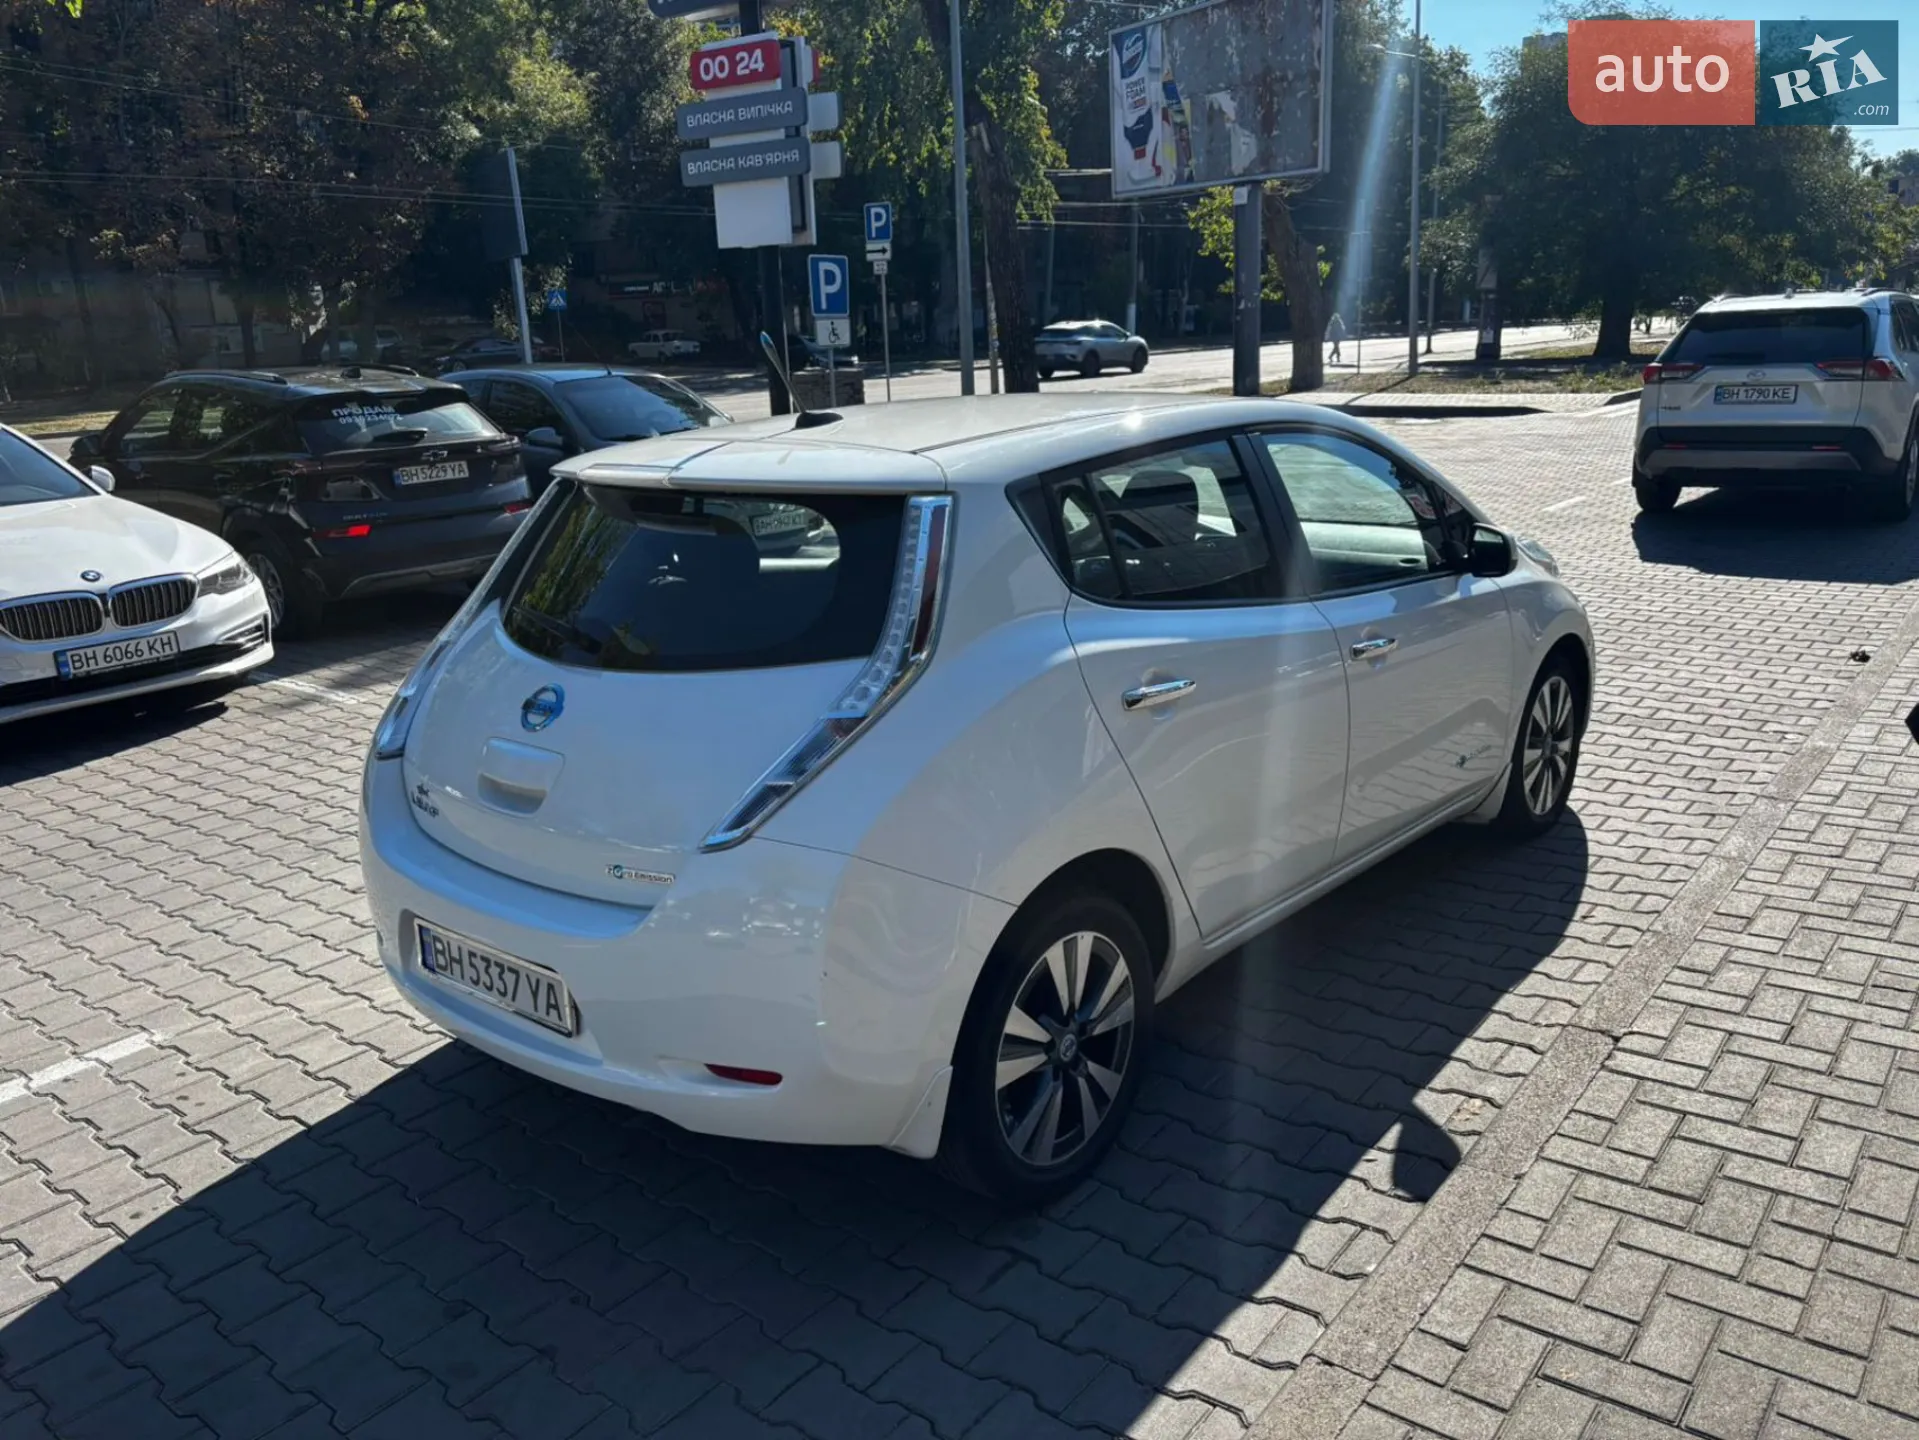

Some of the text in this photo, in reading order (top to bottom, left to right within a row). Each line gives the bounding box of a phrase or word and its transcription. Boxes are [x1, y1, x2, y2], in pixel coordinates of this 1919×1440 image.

[700, 48, 765, 81] 00 24
[686, 101, 793, 128] ВЛАСНА ВИПІЧКА
[687, 149, 800, 175] ВЛАСНА КАВ'ЯРНЯ
[870, 207, 886, 238] P
[818, 261, 842, 310] P
[1722, 387, 1791, 399] BH 1790 KE
[331, 406, 395, 417] ПРОДАМ
[401, 463, 466, 482] BH 5229 YA
[70, 635, 173, 671] BH 6066 KH
[433, 935, 563, 1022] BH 5337 YA
